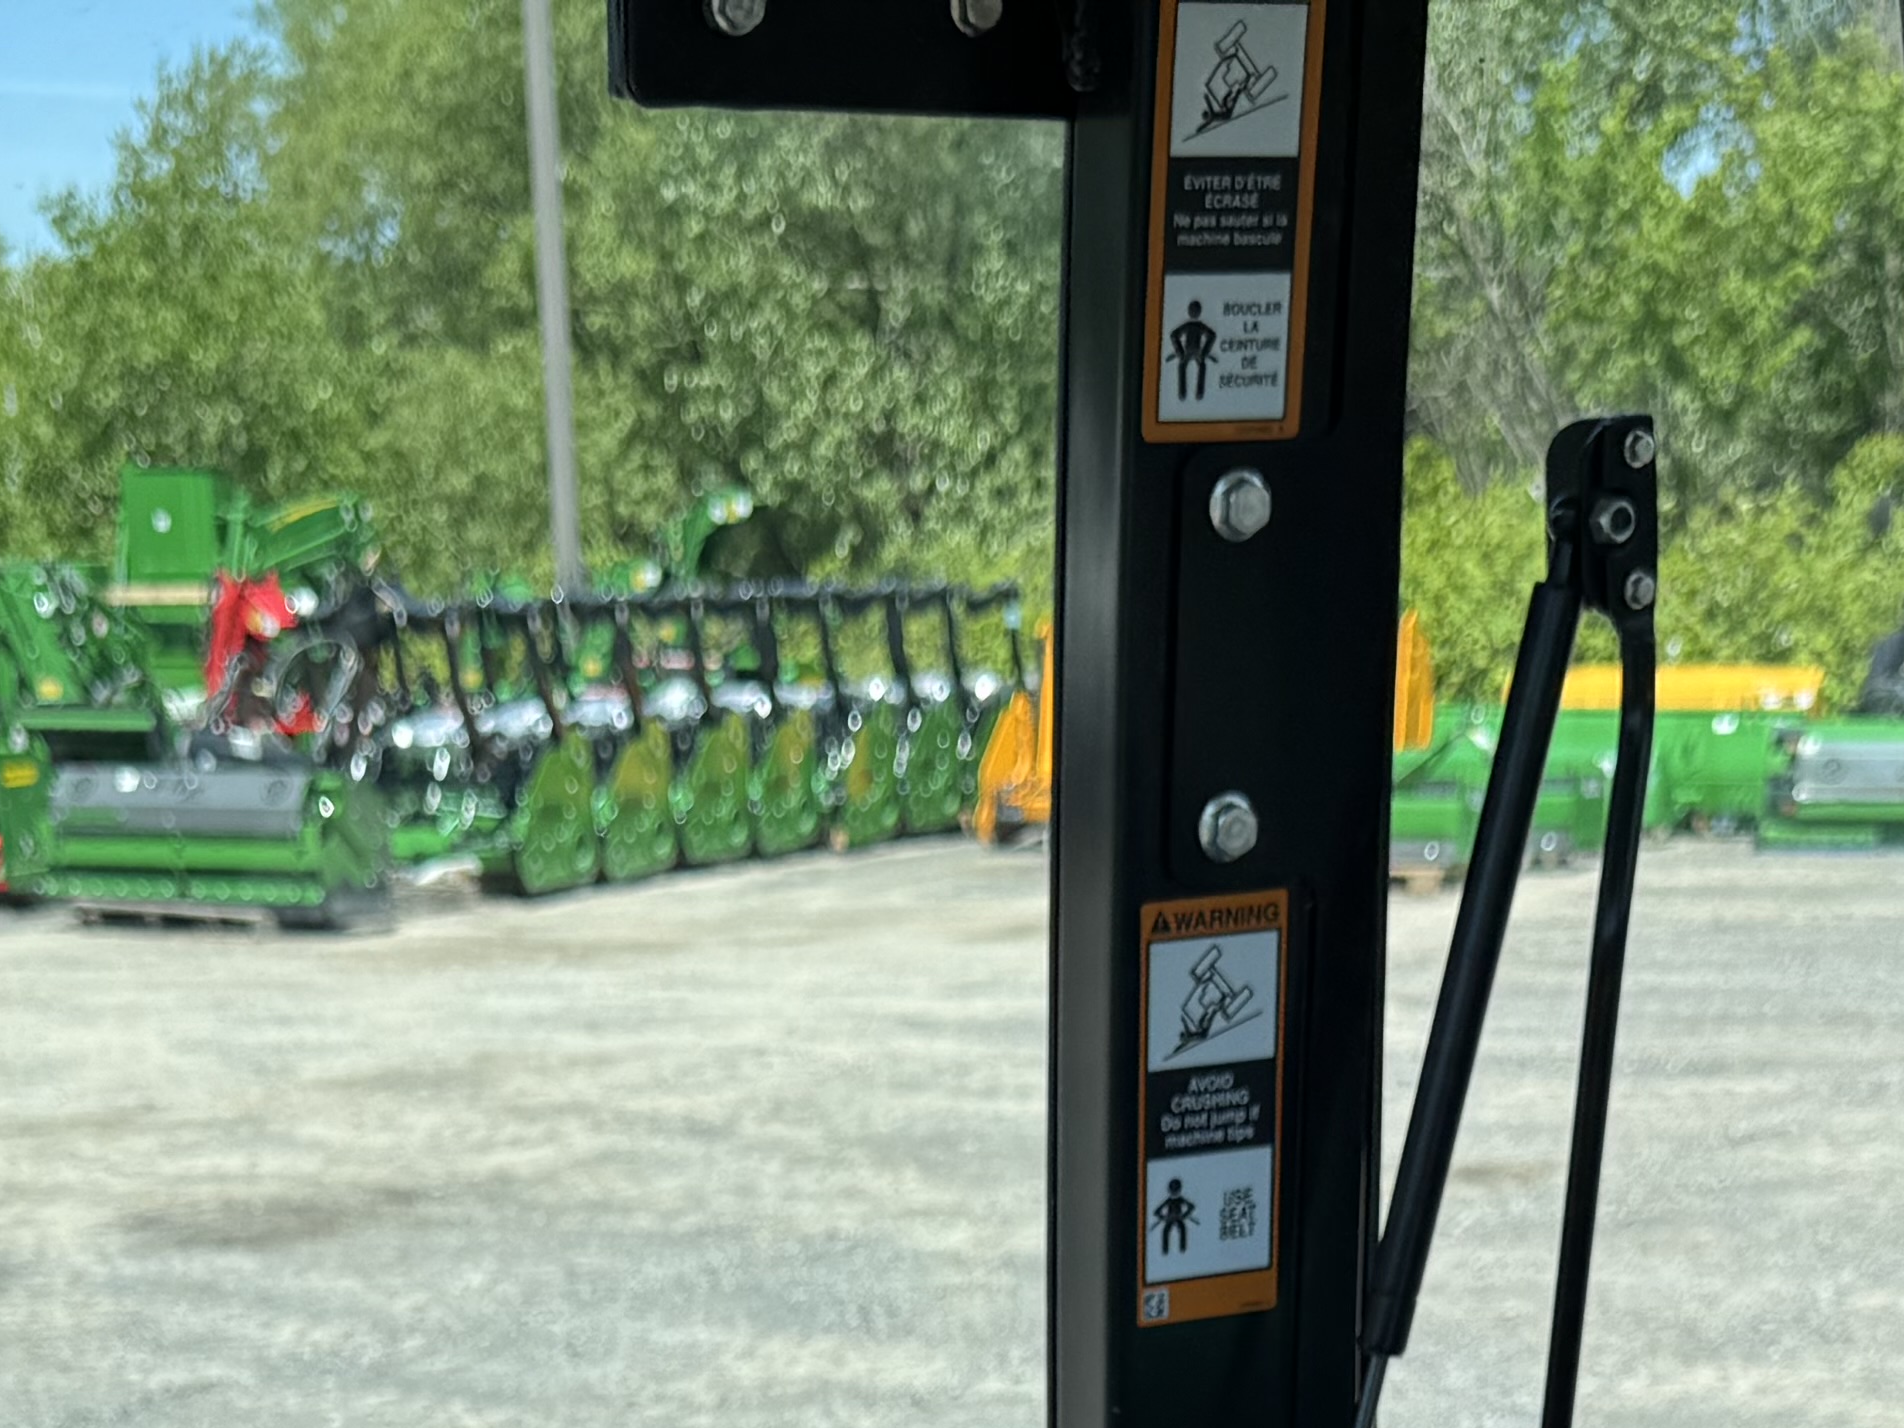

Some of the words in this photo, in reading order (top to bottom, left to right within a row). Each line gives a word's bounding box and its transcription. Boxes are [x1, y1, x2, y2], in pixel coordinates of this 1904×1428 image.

[1183, 173, 1232, 191] ÉVITER
[1204, 191, 1259, 209] ÉCRASÉ
[1222, 301, 1282, 317] BOUCLER
[1242, 320, 1259, 334] LA
[1219, 338, 1281, 353] CEINTURE
[1240, 356, 1258, 370] DE
[1218, 371, 1279, 389] SÉCURITÉ
[1174, 903, 1280, 931] WARNING
[1188, 1072, 1234, 1093] AVOID
[1171, 1088, 1249, 1113] CRUSHING
[1160, 1113, 1183, 1132] Do
[1183, 1111, 1209, 1129] not
[1208, 1106, 1248, 1129] jump
[1164, 1129, 1225, 1149] machine
